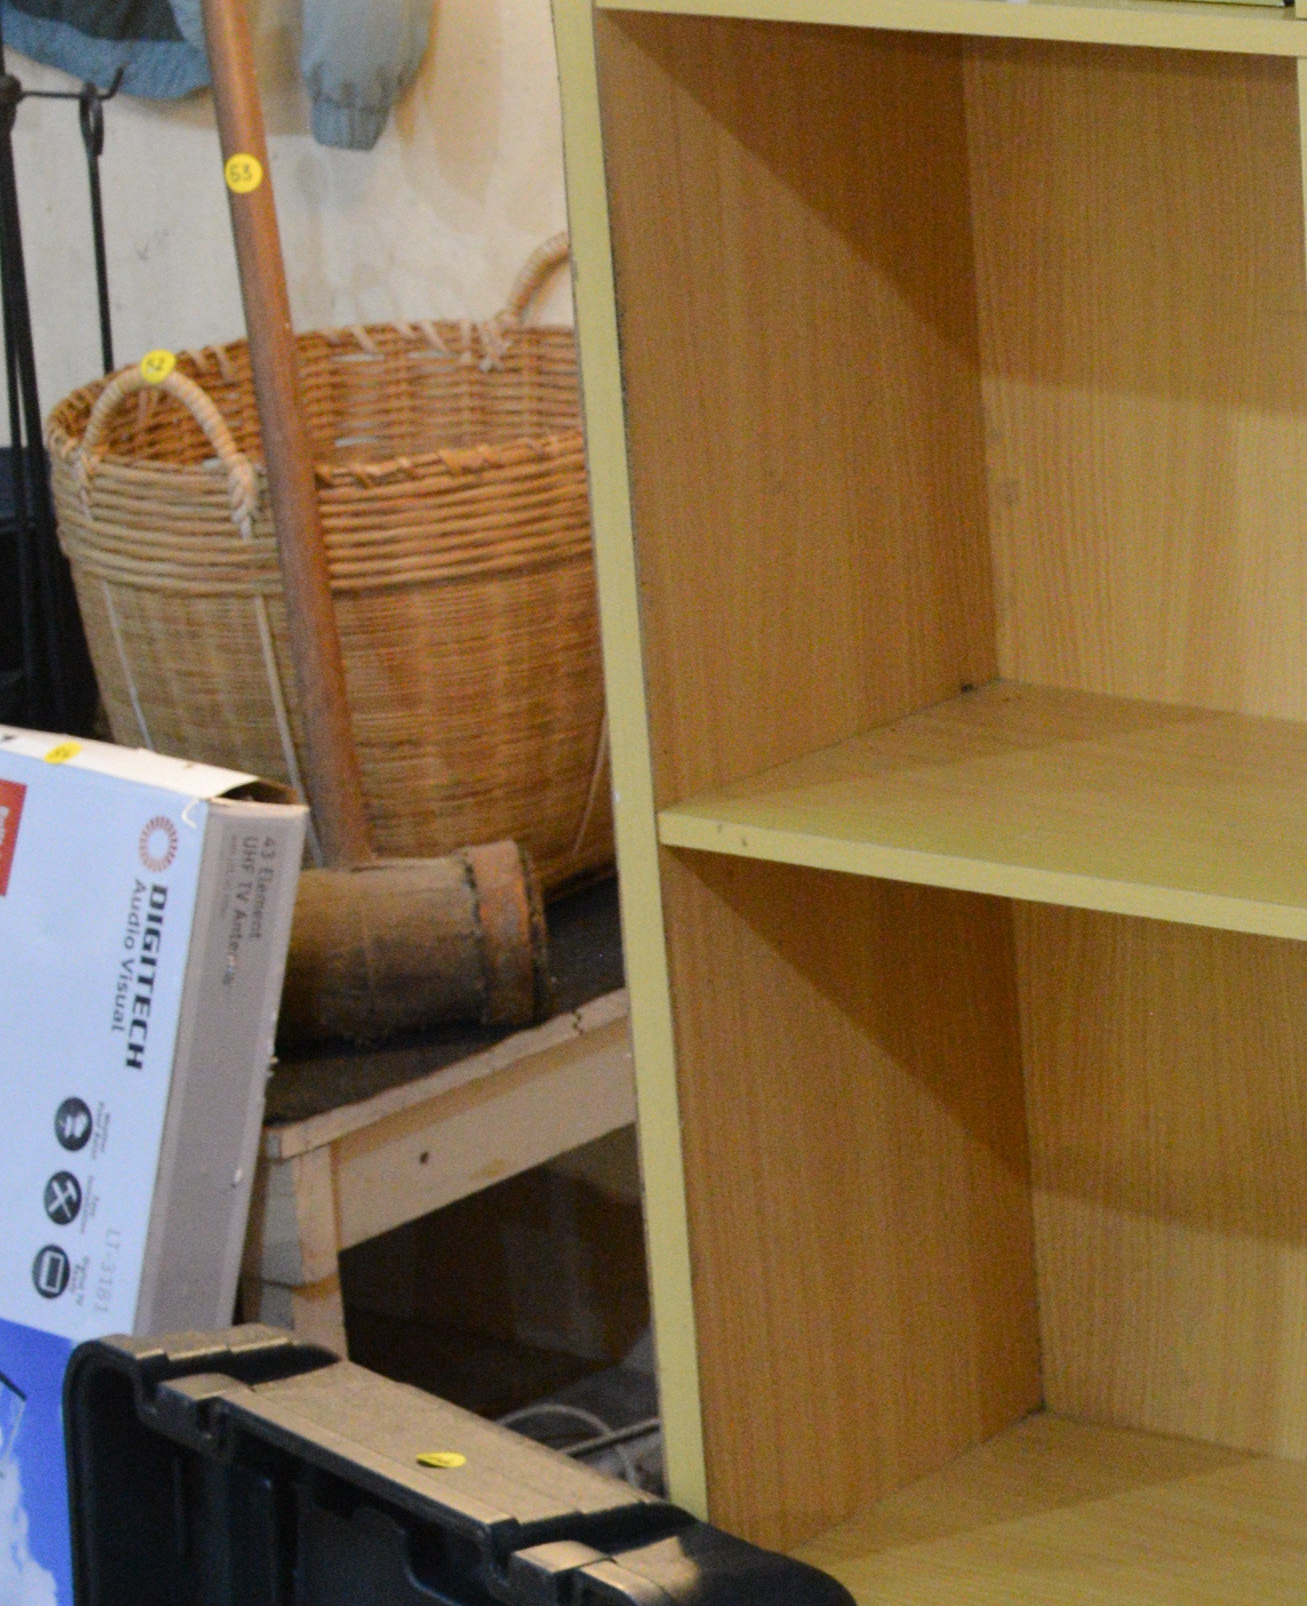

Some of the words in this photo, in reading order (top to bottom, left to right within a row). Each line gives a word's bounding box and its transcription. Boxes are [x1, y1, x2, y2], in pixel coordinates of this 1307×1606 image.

[241, 836, 259, 874] UHF
[261, 836, 276, 859] 43
[124, 879, 147, 949] Audio
[236, 882, 252, 902] TV
[250, 866, 275, 940] Element
[111, 958, 134, 1032] Visual
[126, 885, 168, 1070] DIGITECH
